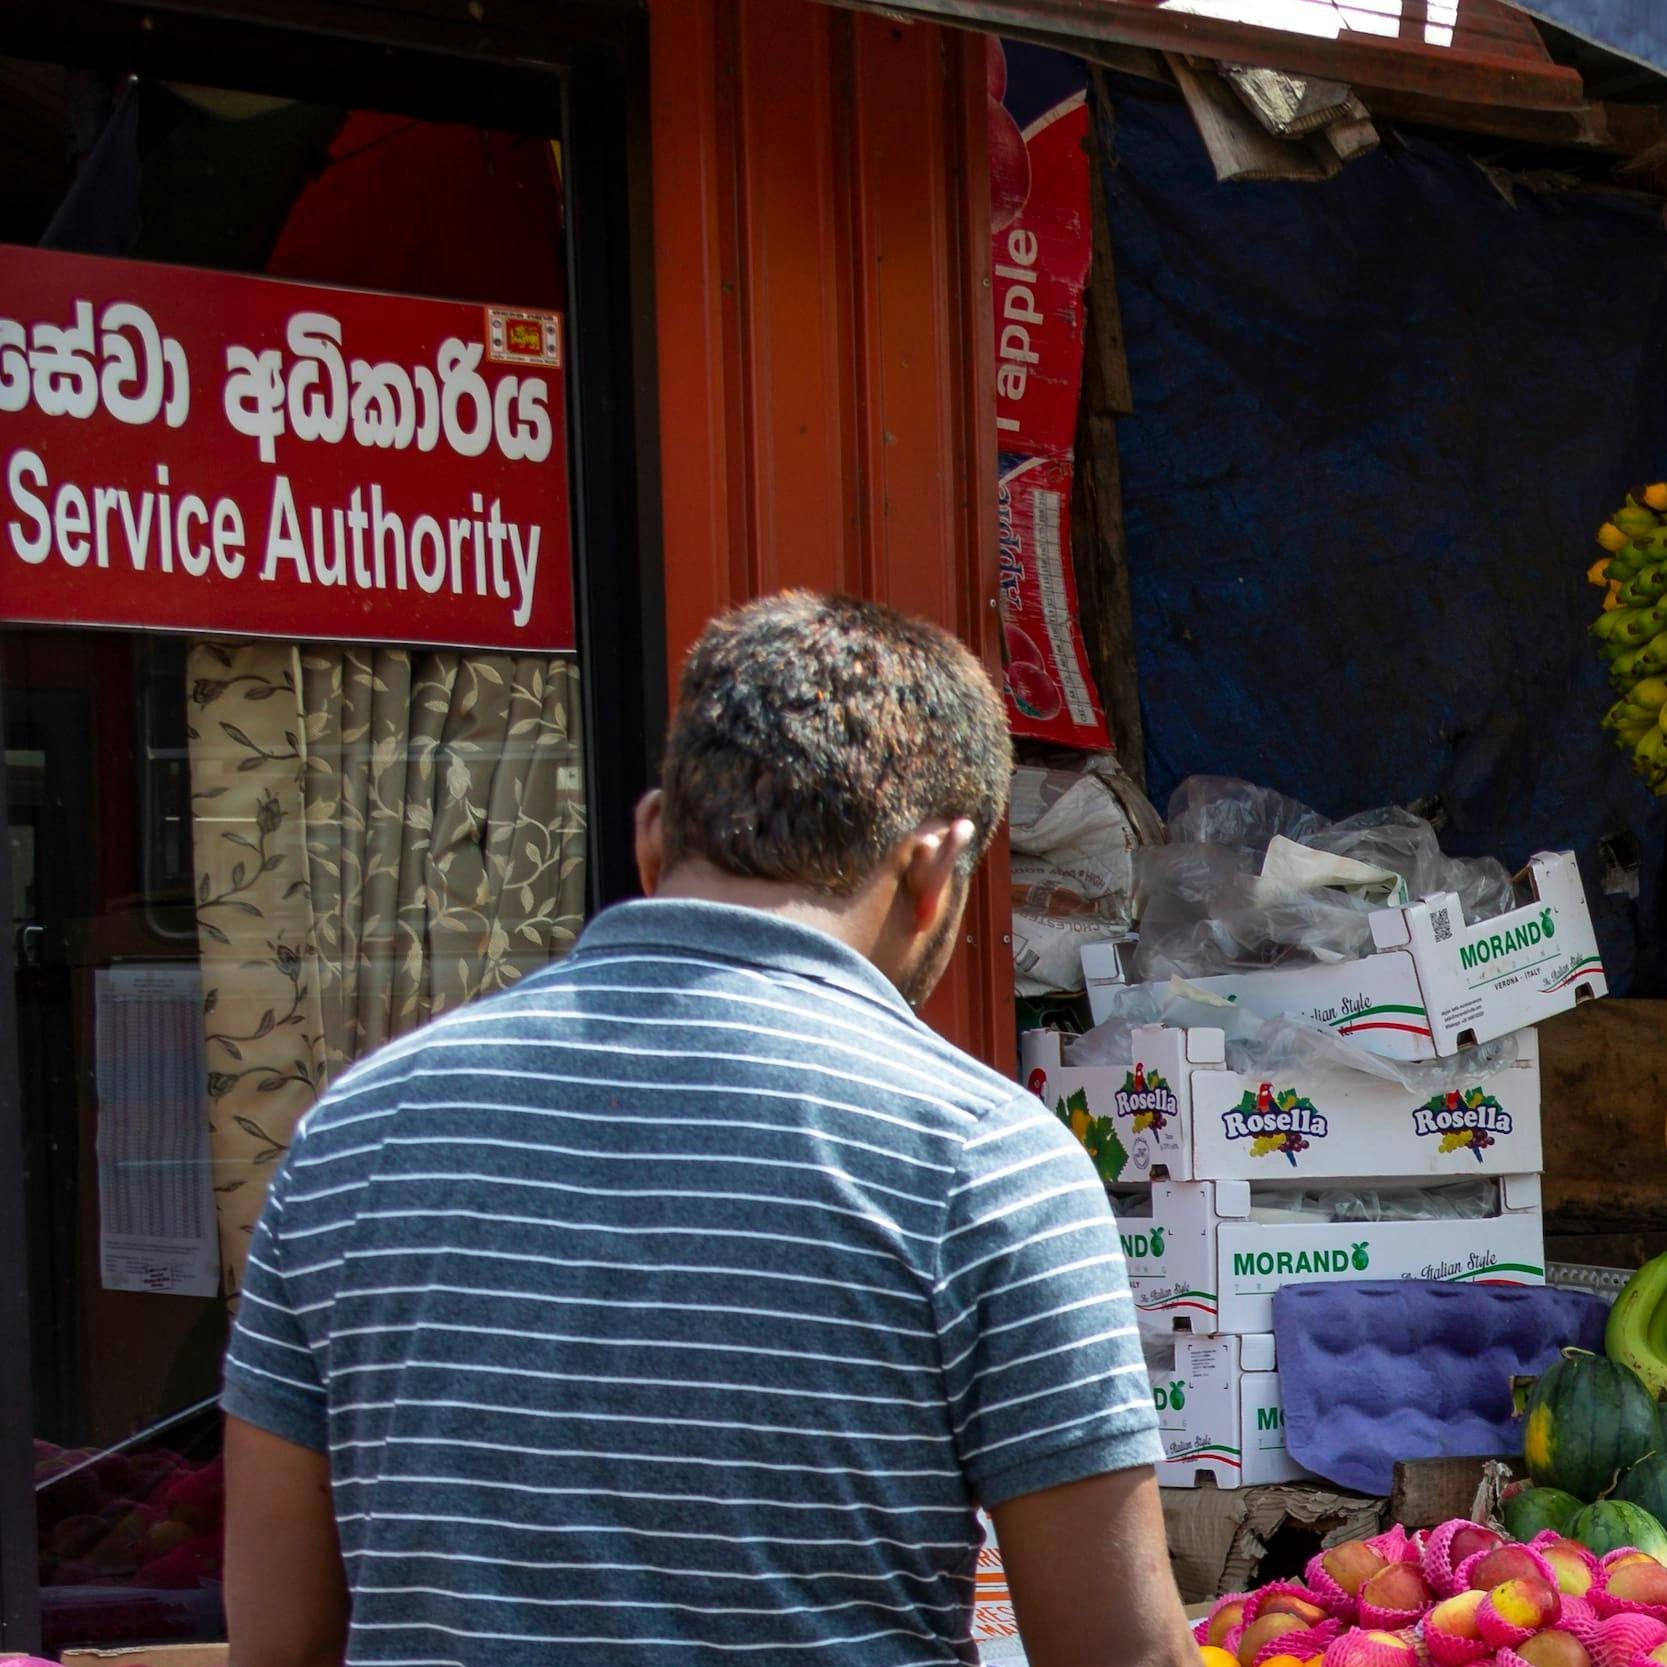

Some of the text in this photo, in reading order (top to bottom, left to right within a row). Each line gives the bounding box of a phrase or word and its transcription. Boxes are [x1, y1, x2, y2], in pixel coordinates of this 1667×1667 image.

[994, 228, 1044, 401] apple
[7, 449, 541, 627] Service Authority
[1494, 976, 1519, 991] VERONA
[1524, 967, 1542, 980] ITALY
[1341, 992, 1373, 1017] Style
[1115, 1088, 1177, 1117] Rosella
[1222, 1107, 1328, 1140] Rosella
[1413, 1104, 1513, 1137] Rosella
[1467, 1249, 1497, 1271] Style
